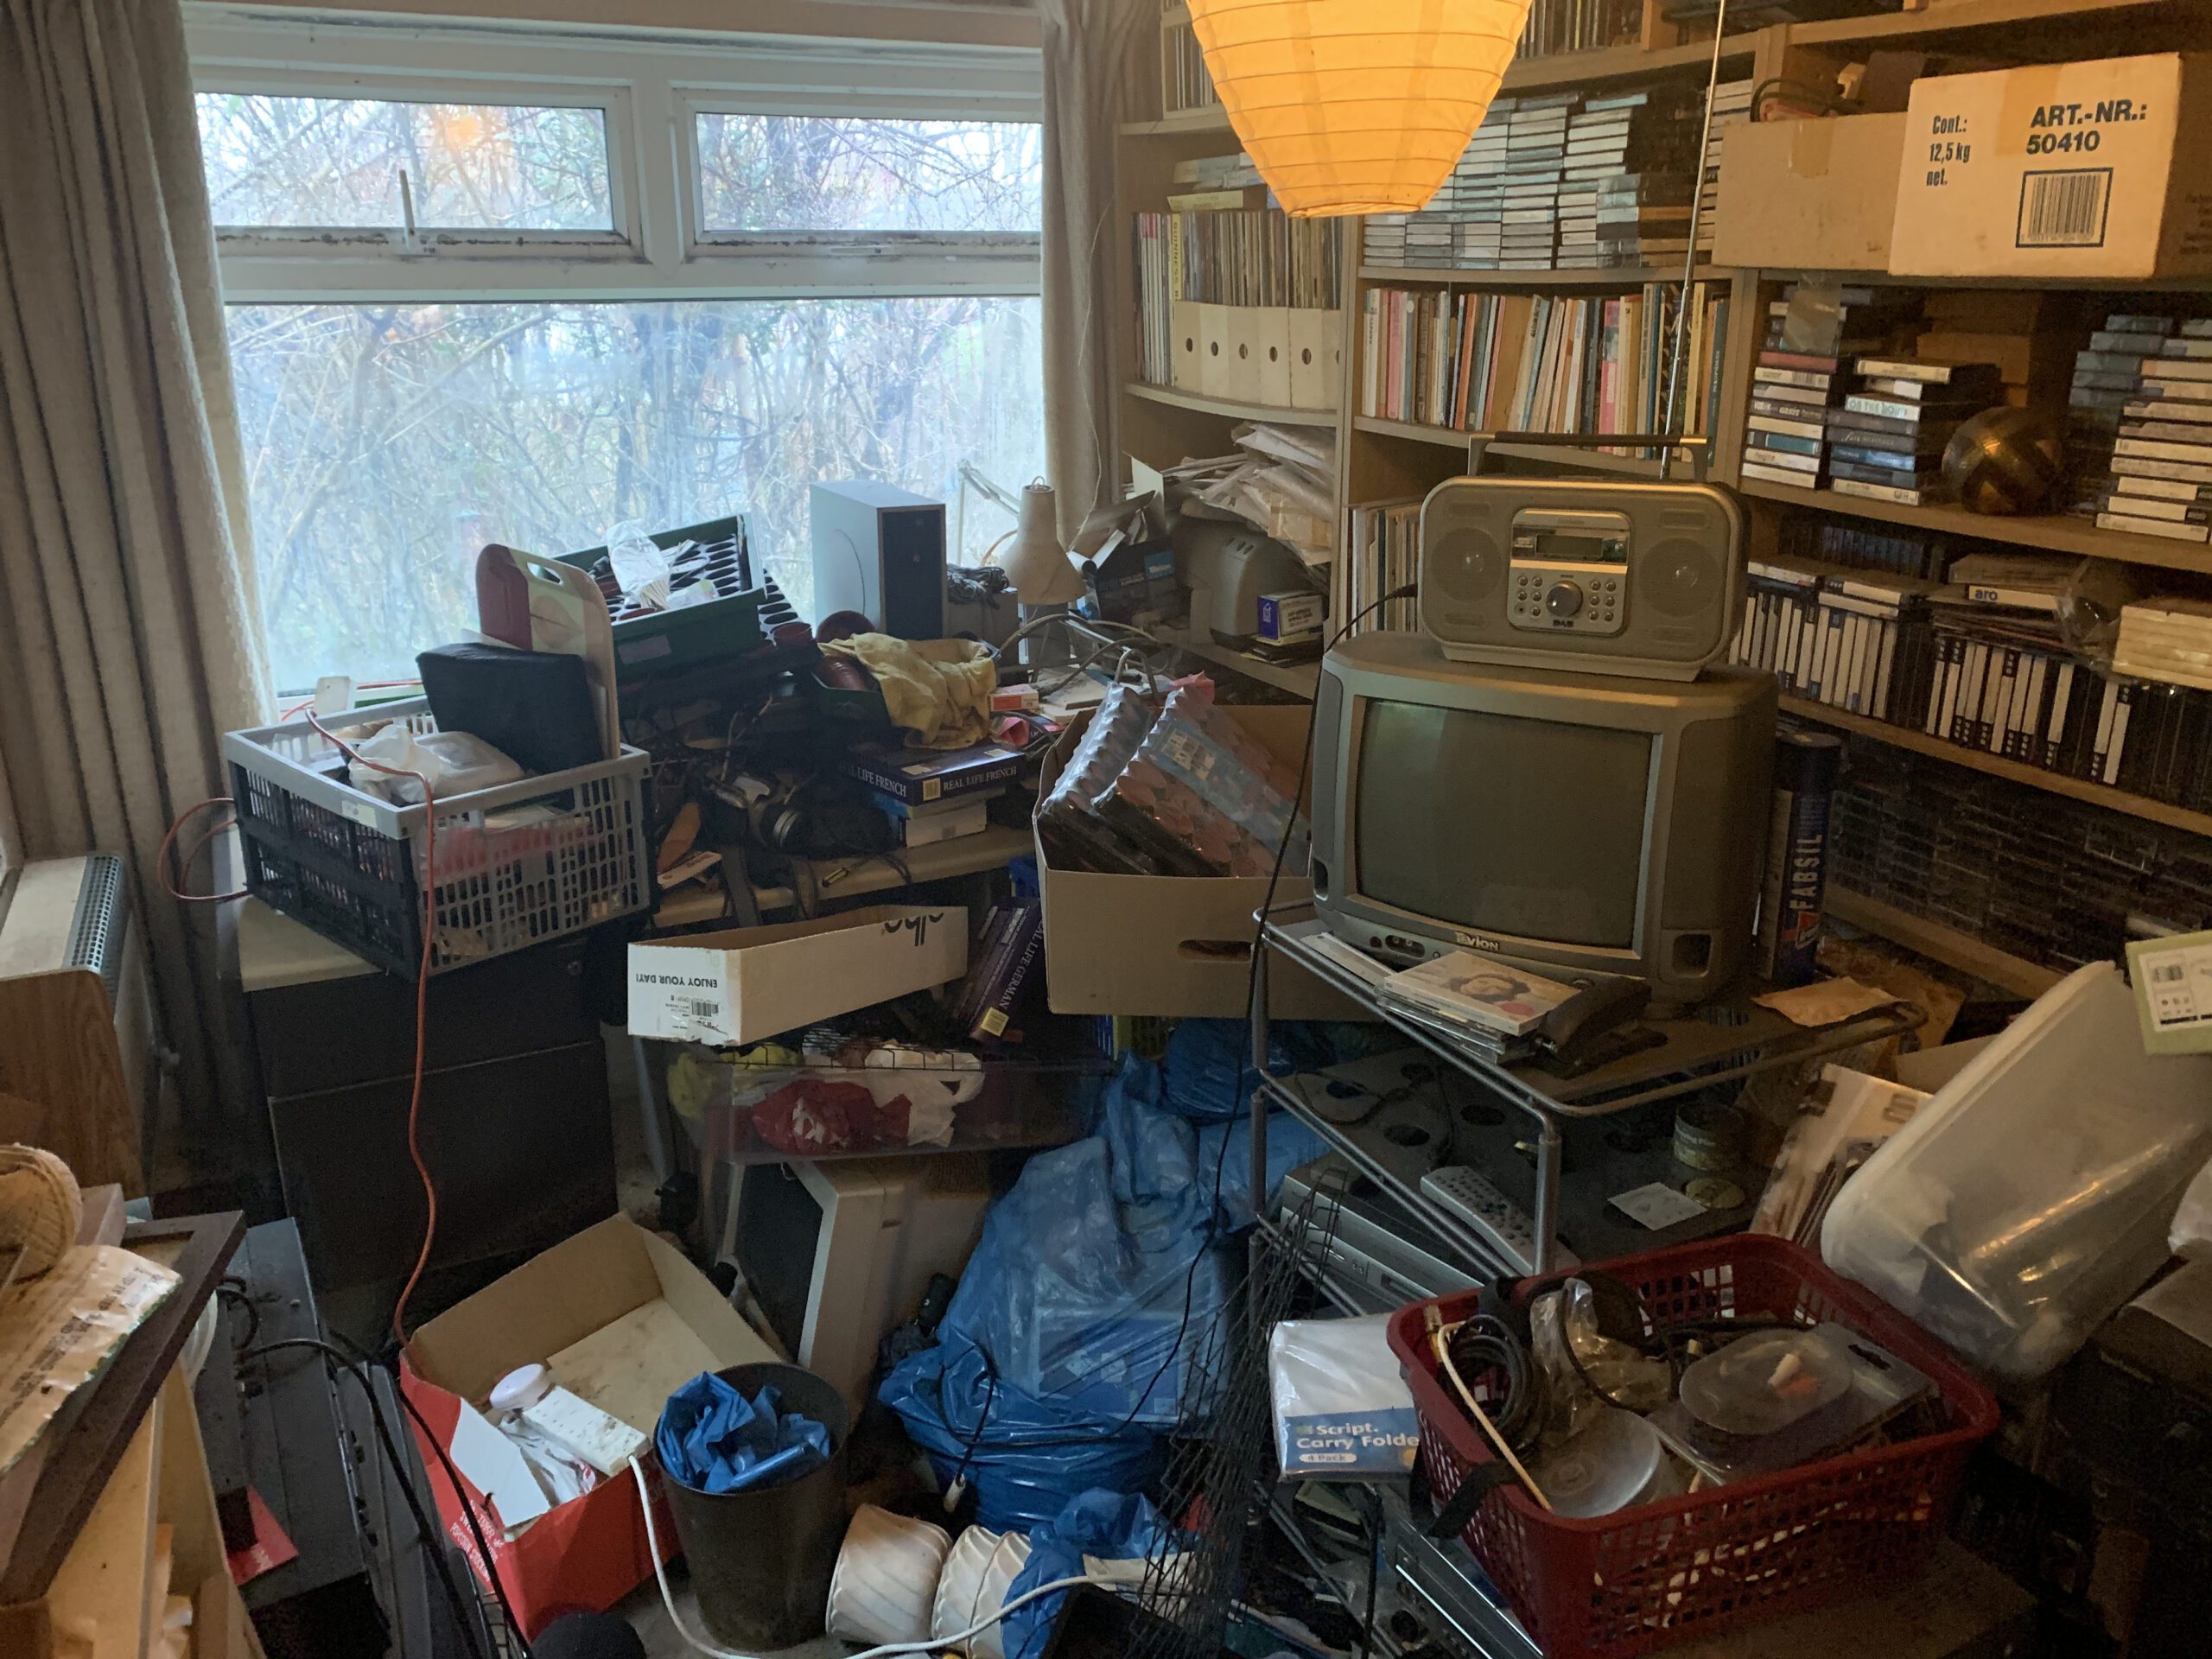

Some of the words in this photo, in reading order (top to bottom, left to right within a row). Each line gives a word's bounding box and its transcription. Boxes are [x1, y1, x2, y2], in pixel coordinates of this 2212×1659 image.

[2031, 99, 2147, 128] ART.-NR.:
[1932, 115, 1967, 135] Cont.:
[1929, 143, 1954, 163] 12,5
[1955, 142, 1970, 163] kg
[2026, 130, 2100, 155] 50410
[1926, 168, 1948, 186] net.
[1975, 589, 1998, 601] aro
[857, 766, 874, 785] LIFE
[875, 774, 906, 797] FRENCH
[944, 778, 963, 791] REAL
[966, 773, 985, 785] LIFE
[986, 766, 1017, 782] FRENCH
[1789, 834, 1823, 909] FABSIL
[1020, 943, 1038, 967] LIFE
[636, 974, 656, 983] DAY!
[659, 976, 685, 986] YOUR
[688, 978, 717, 988] ENJOY
[1000, 966, 1026, 1010] GERMAN
[1316, 1423, 1379, 1435] Script.
[1297, 1437, 1354, 1450] Carry
[1362, 1433, 1419, 1446] Folde
